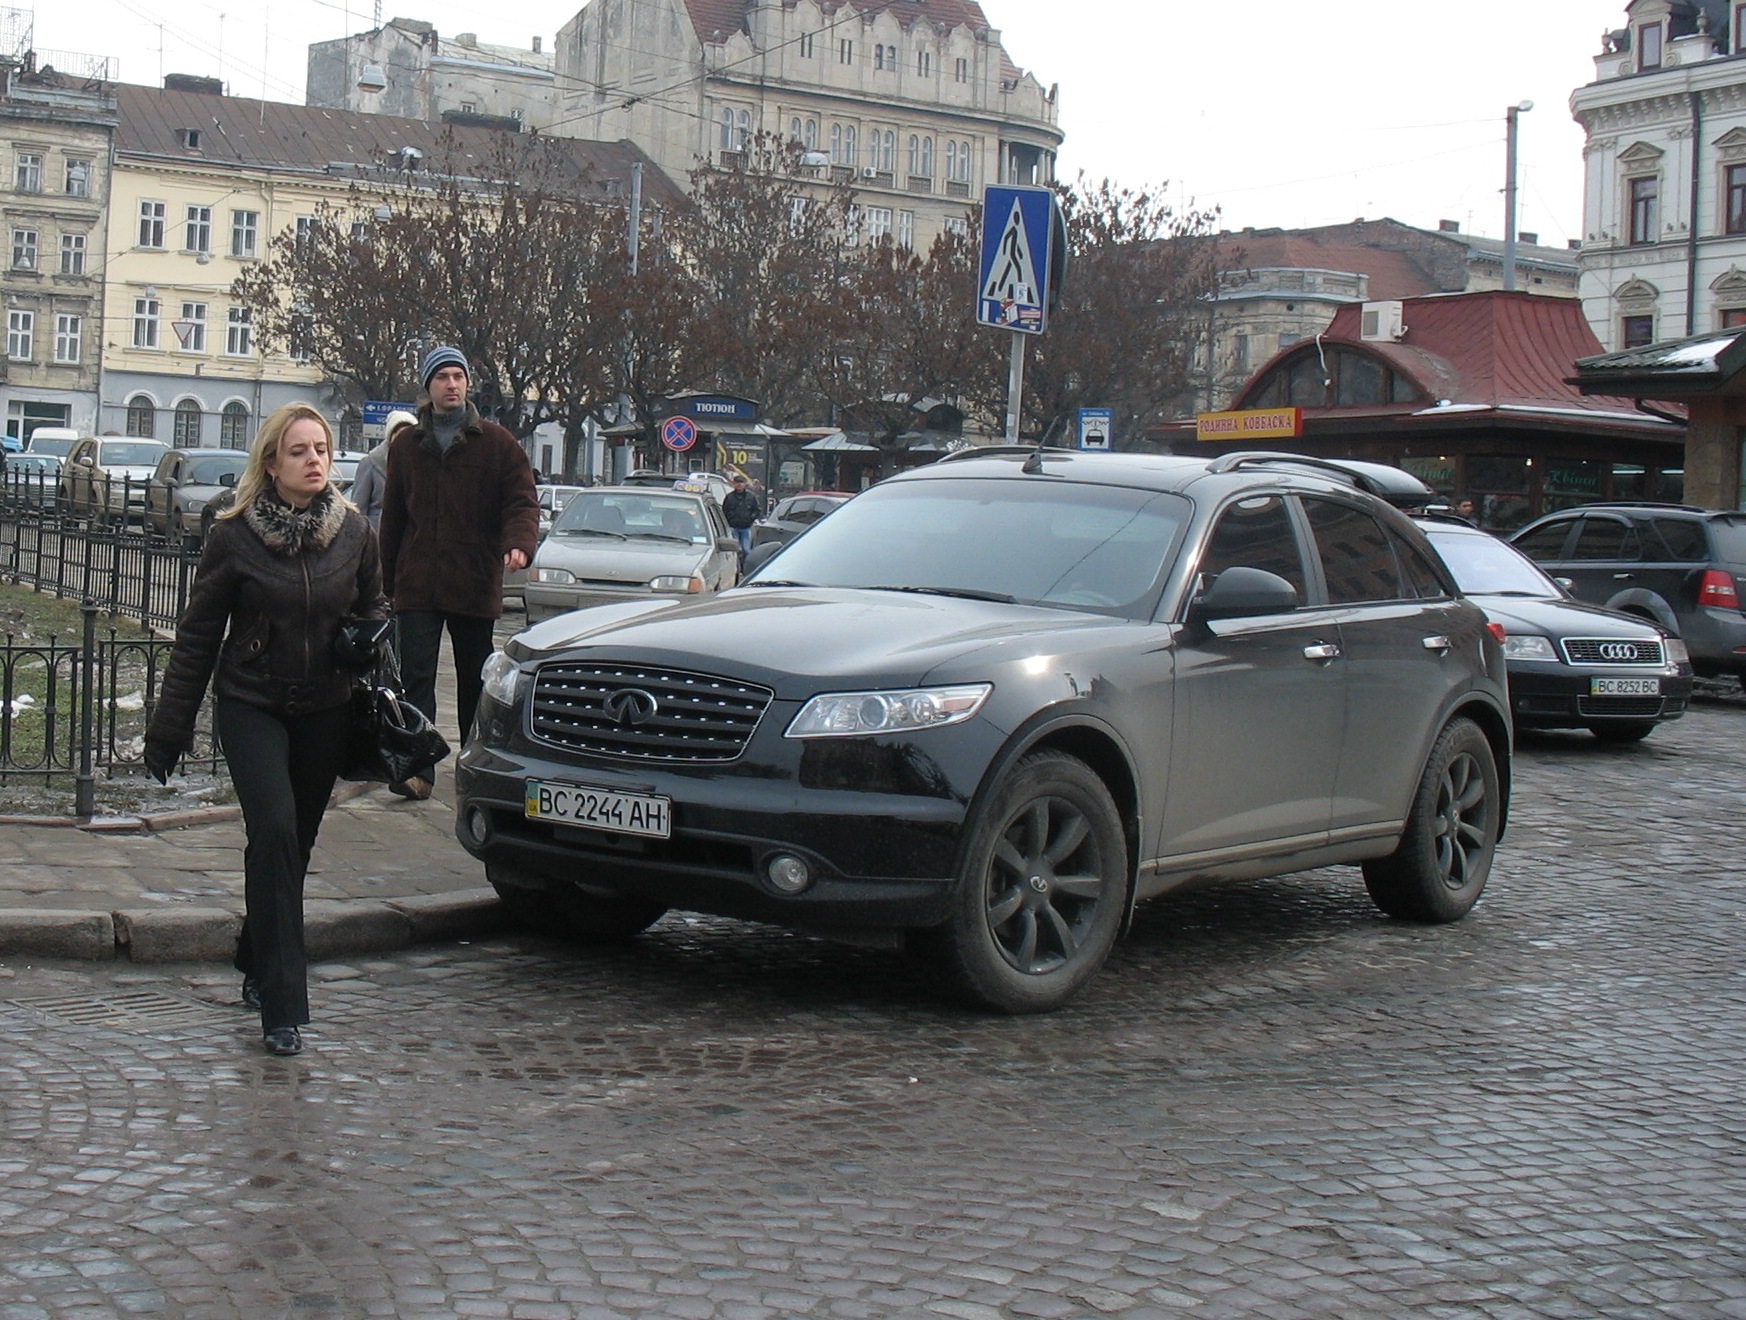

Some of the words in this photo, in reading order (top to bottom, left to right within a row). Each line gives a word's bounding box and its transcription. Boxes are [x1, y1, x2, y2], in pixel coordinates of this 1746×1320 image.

[696, 403, 736, 414] ТЮТЮН
[1243, 414, 1292, 431] КОВБАСКА
[732, 450, 747, 465] 10
[1598, 680, 1615, 693] BC
[1617, 680, 1640, 693] 8252
[539, 787, 568, 816] BC
[574, 792, 623, 826] 2244
[629, 800, 662, 831] AH
